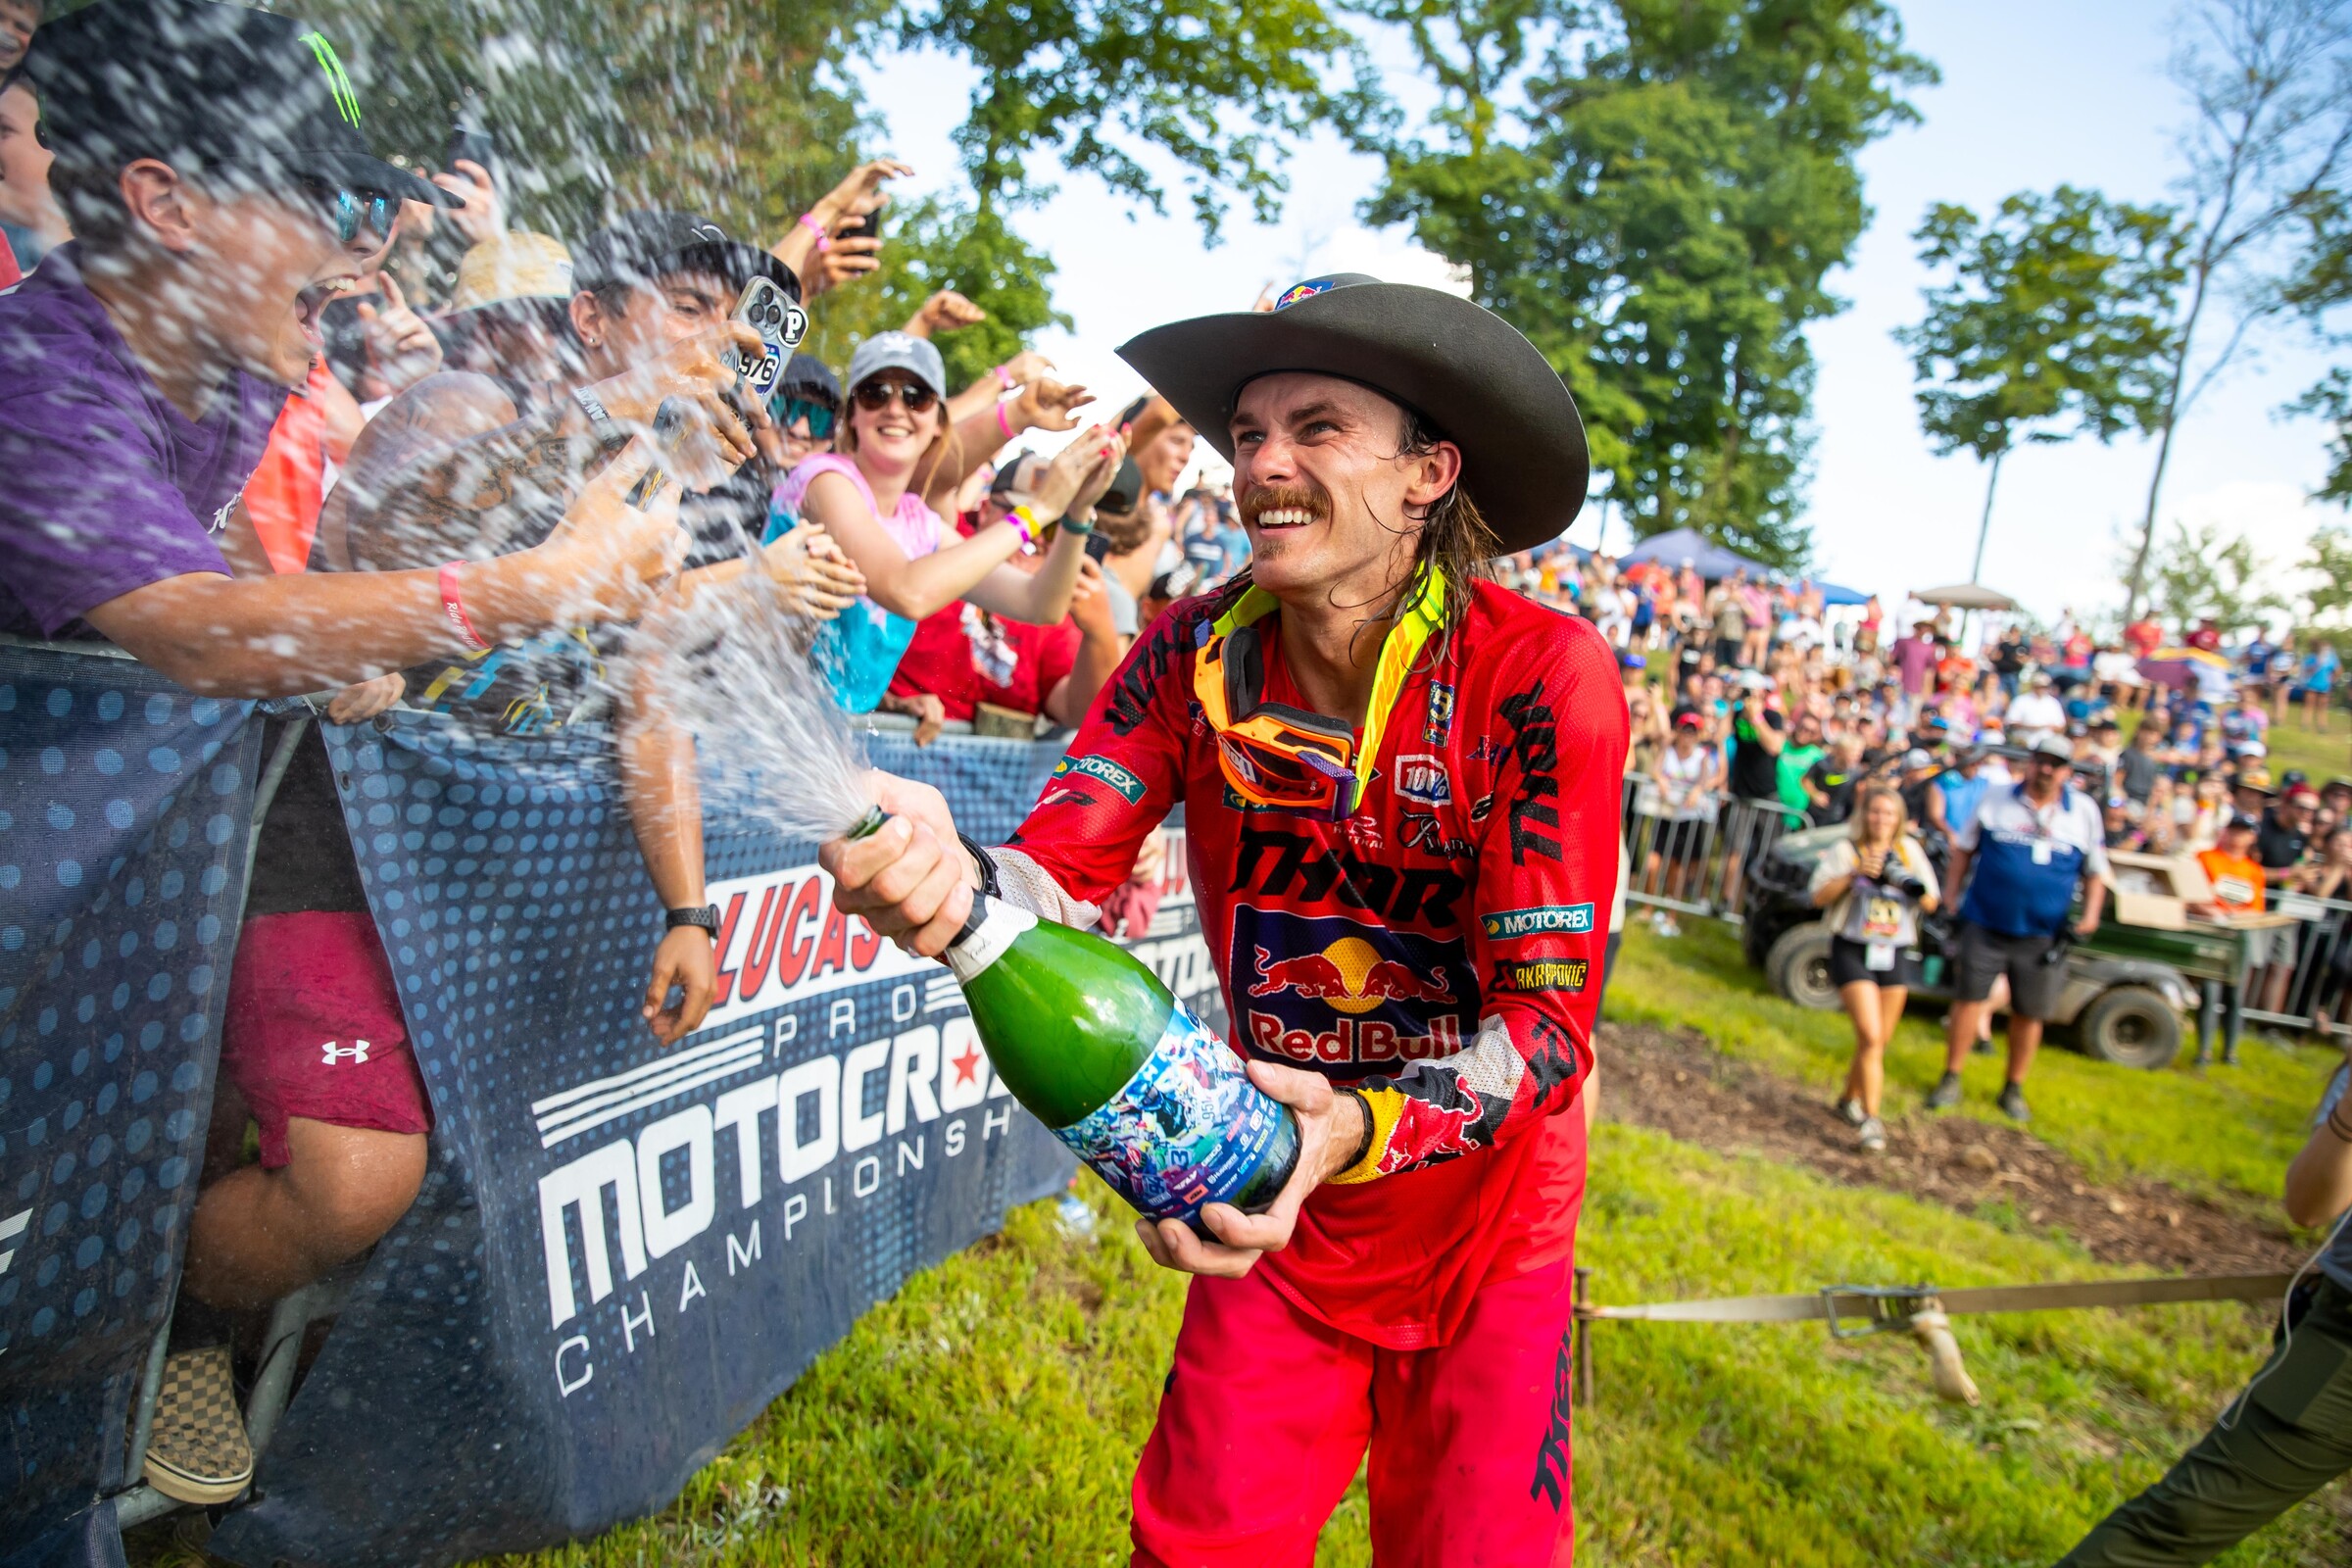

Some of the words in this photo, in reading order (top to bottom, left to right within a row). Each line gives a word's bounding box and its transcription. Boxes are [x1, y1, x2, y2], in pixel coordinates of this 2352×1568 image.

[1072, 757, 1138, 796] TOREX
[1498, 677, 1563, 867] THOR
[1227, 827, 1467, 928] THOR
[1503, 908, 1589, 934] MOTOREX
[710, 875, 881, 1007] LUCAS
[772, 983, 918, 1059] PRO
[1249, 1007, 1353, 1064] Red
[1358, 1012, 1463, 1064] Bull
[537, 1016, 1016, 1331] MOTOCRO
